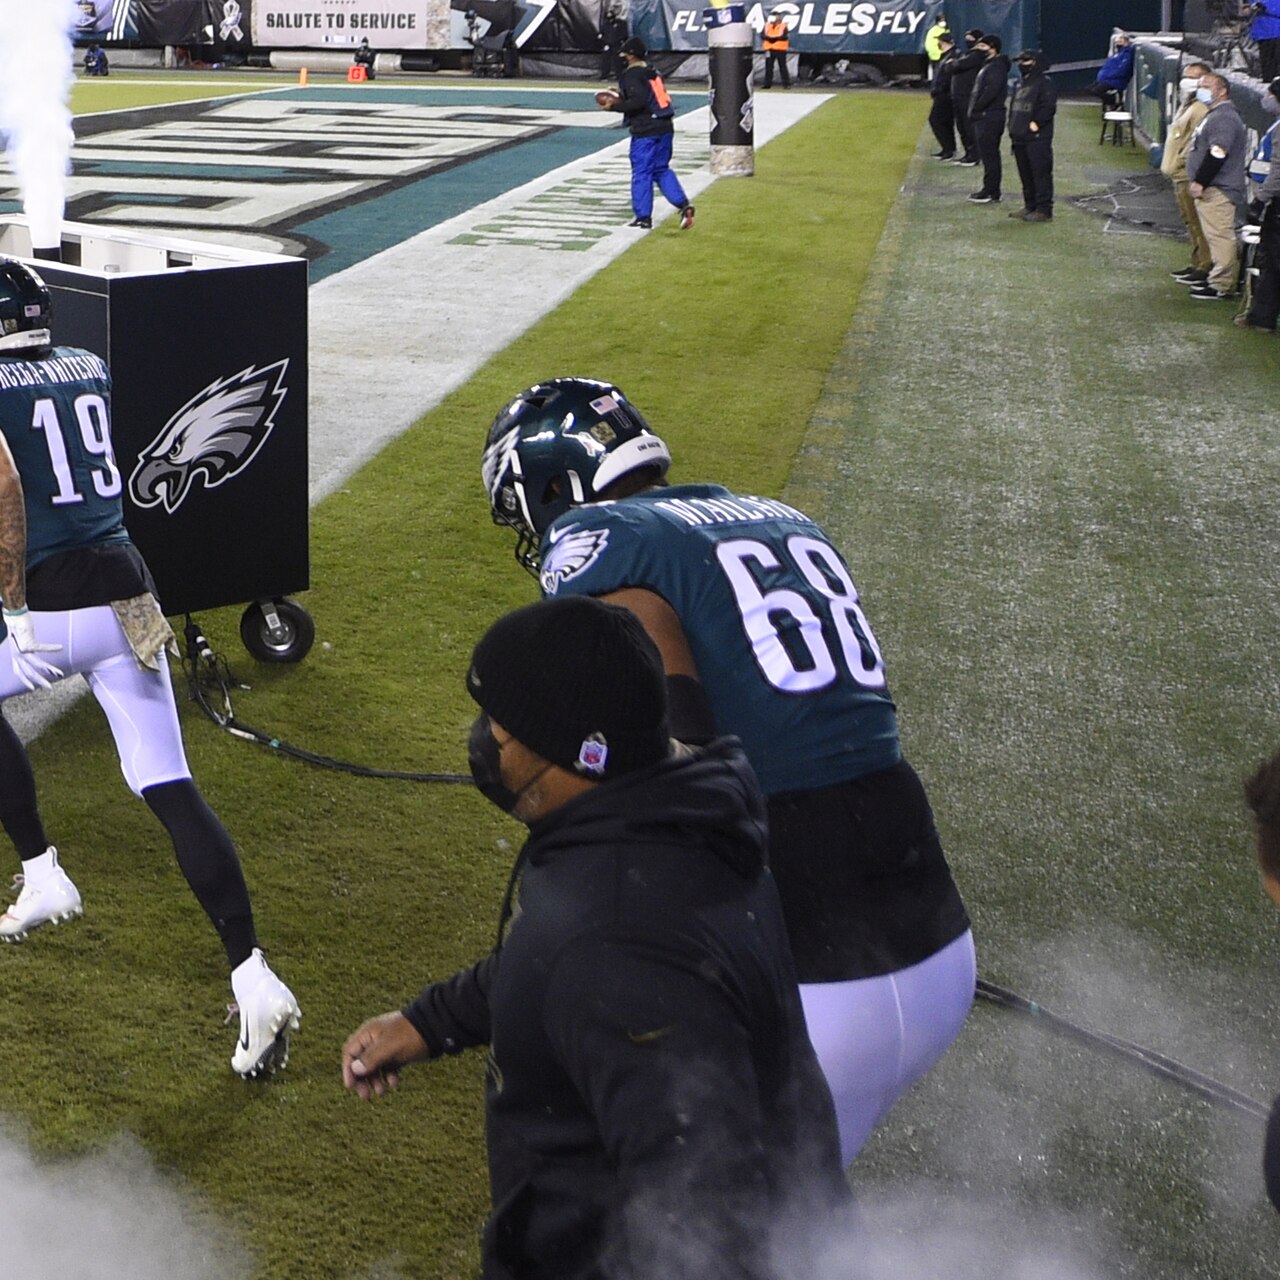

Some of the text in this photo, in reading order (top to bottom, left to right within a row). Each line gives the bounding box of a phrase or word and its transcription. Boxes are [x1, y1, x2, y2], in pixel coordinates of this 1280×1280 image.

[266, 12, 417, 30] SALUTE TO SERVICE
[671, 10, 708, 32] FL
[744, 2, 878, 35] AGLES
[31, 392, 123, 507] 19
[715, 534, 888, 694] 68
